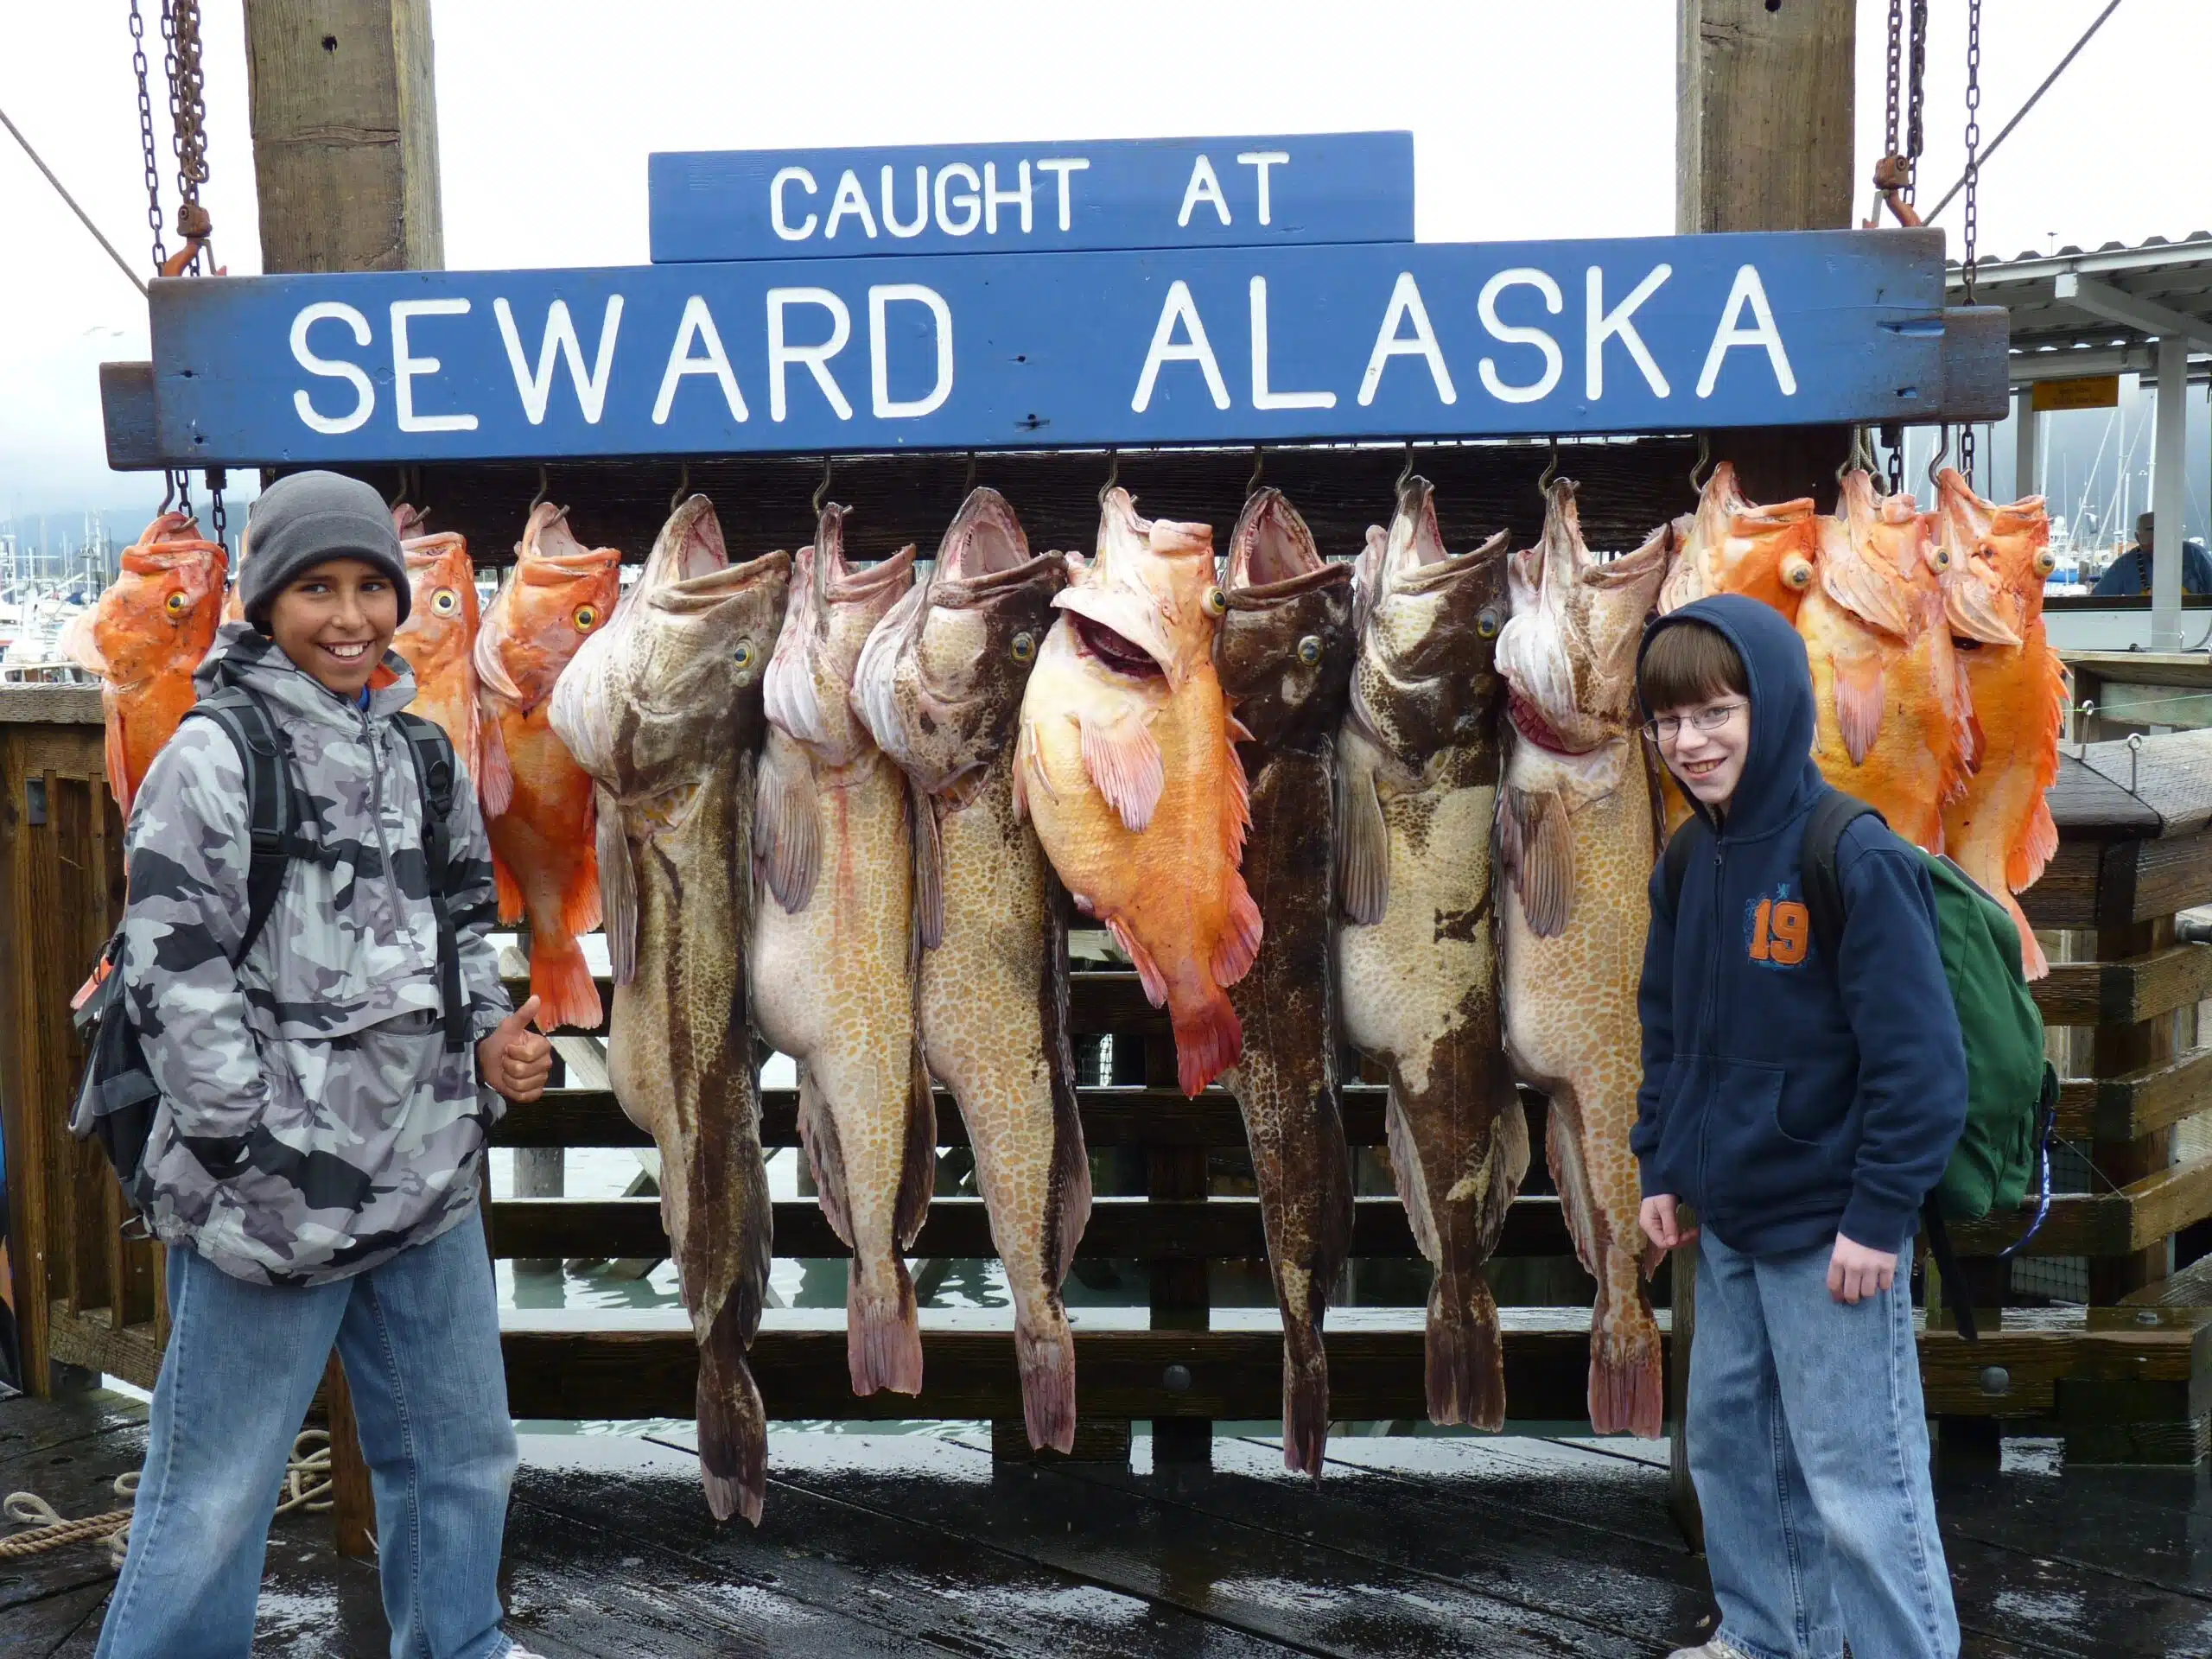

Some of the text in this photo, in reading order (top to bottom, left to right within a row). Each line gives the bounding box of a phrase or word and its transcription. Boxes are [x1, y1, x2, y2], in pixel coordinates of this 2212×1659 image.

[770, 151, 1291, 241] CAUGHT AT
[289, 264, 1798, 435] SEWARD ALASKA
[1749, 899, 1809, 964] 19
